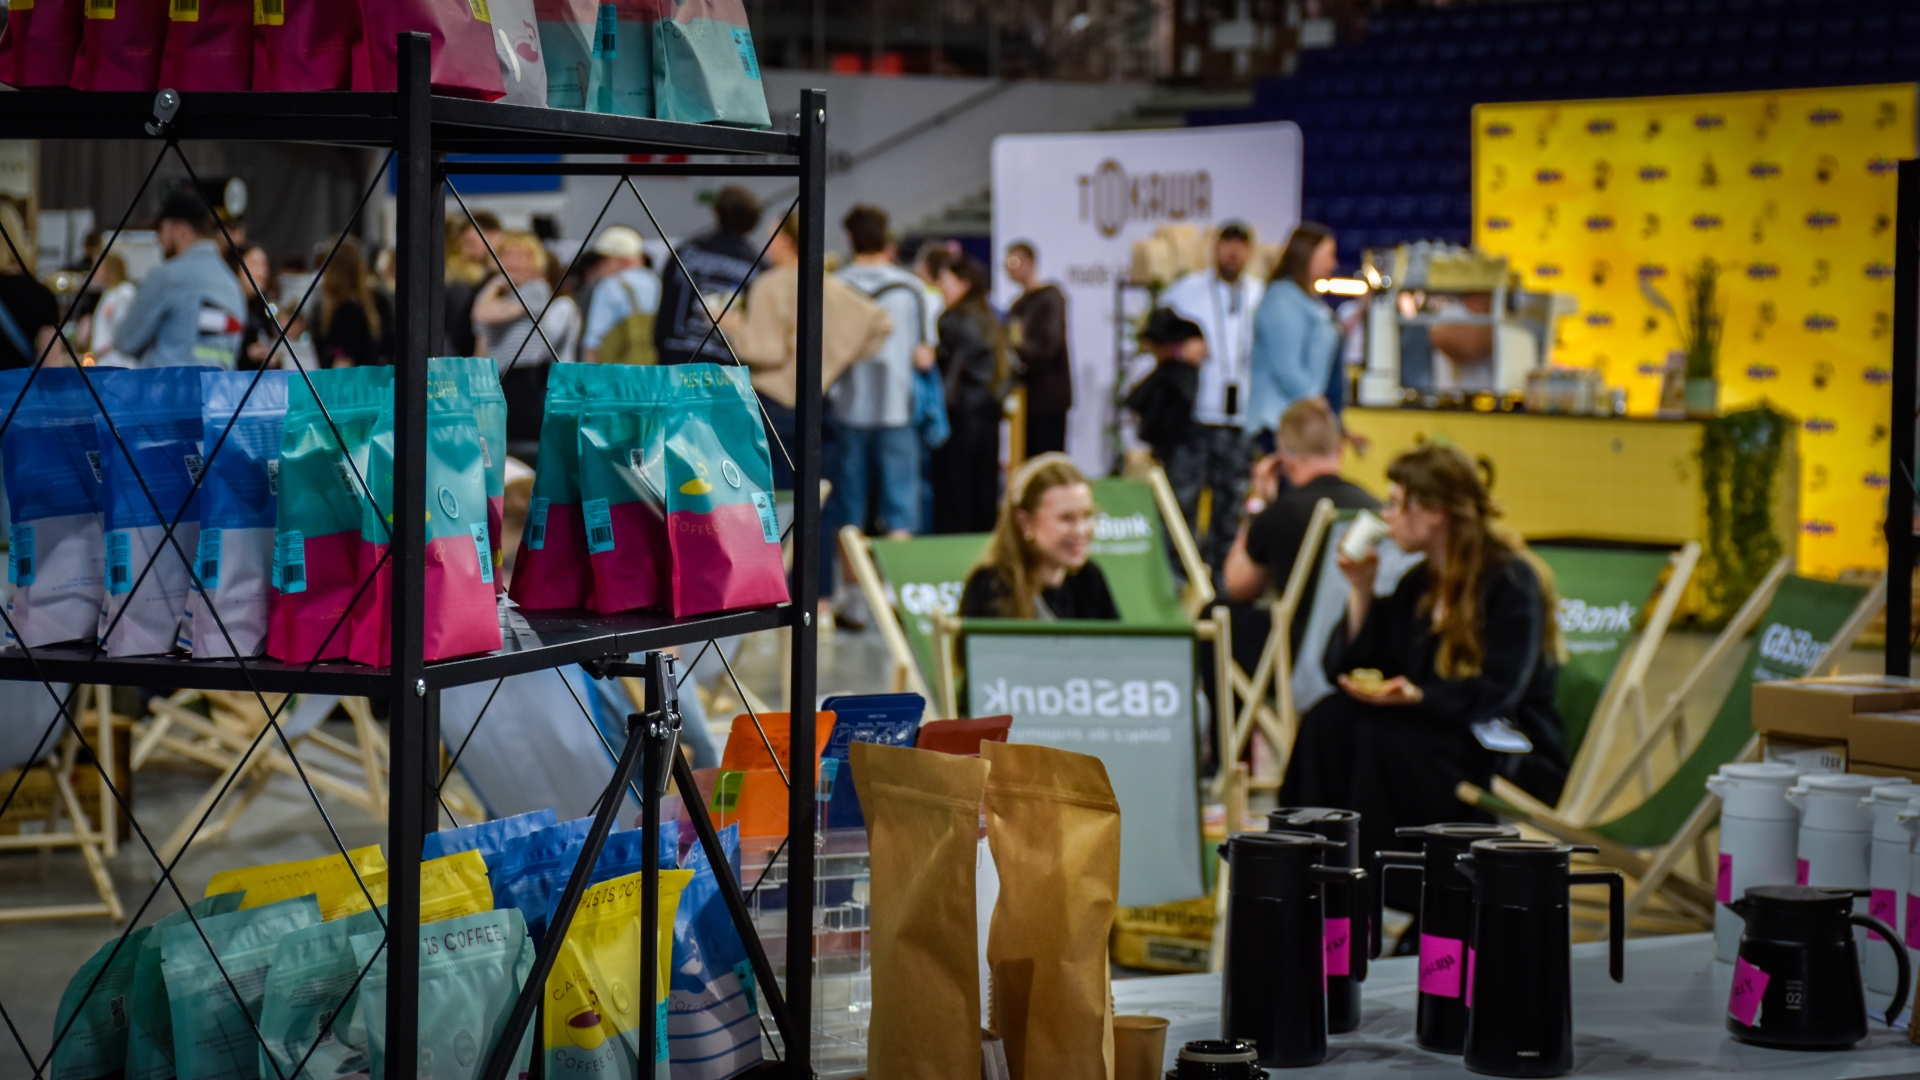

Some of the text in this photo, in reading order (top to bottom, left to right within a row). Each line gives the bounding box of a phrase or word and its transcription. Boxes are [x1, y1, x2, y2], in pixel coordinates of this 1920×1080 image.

[1077, 158, 1212, 237] TOKAWA
[423, 924, 507, 955] IS COFFEE.
[1786, 992, 1802, 1004] 02
[555, 1049, 605, 1074] COFFEE
